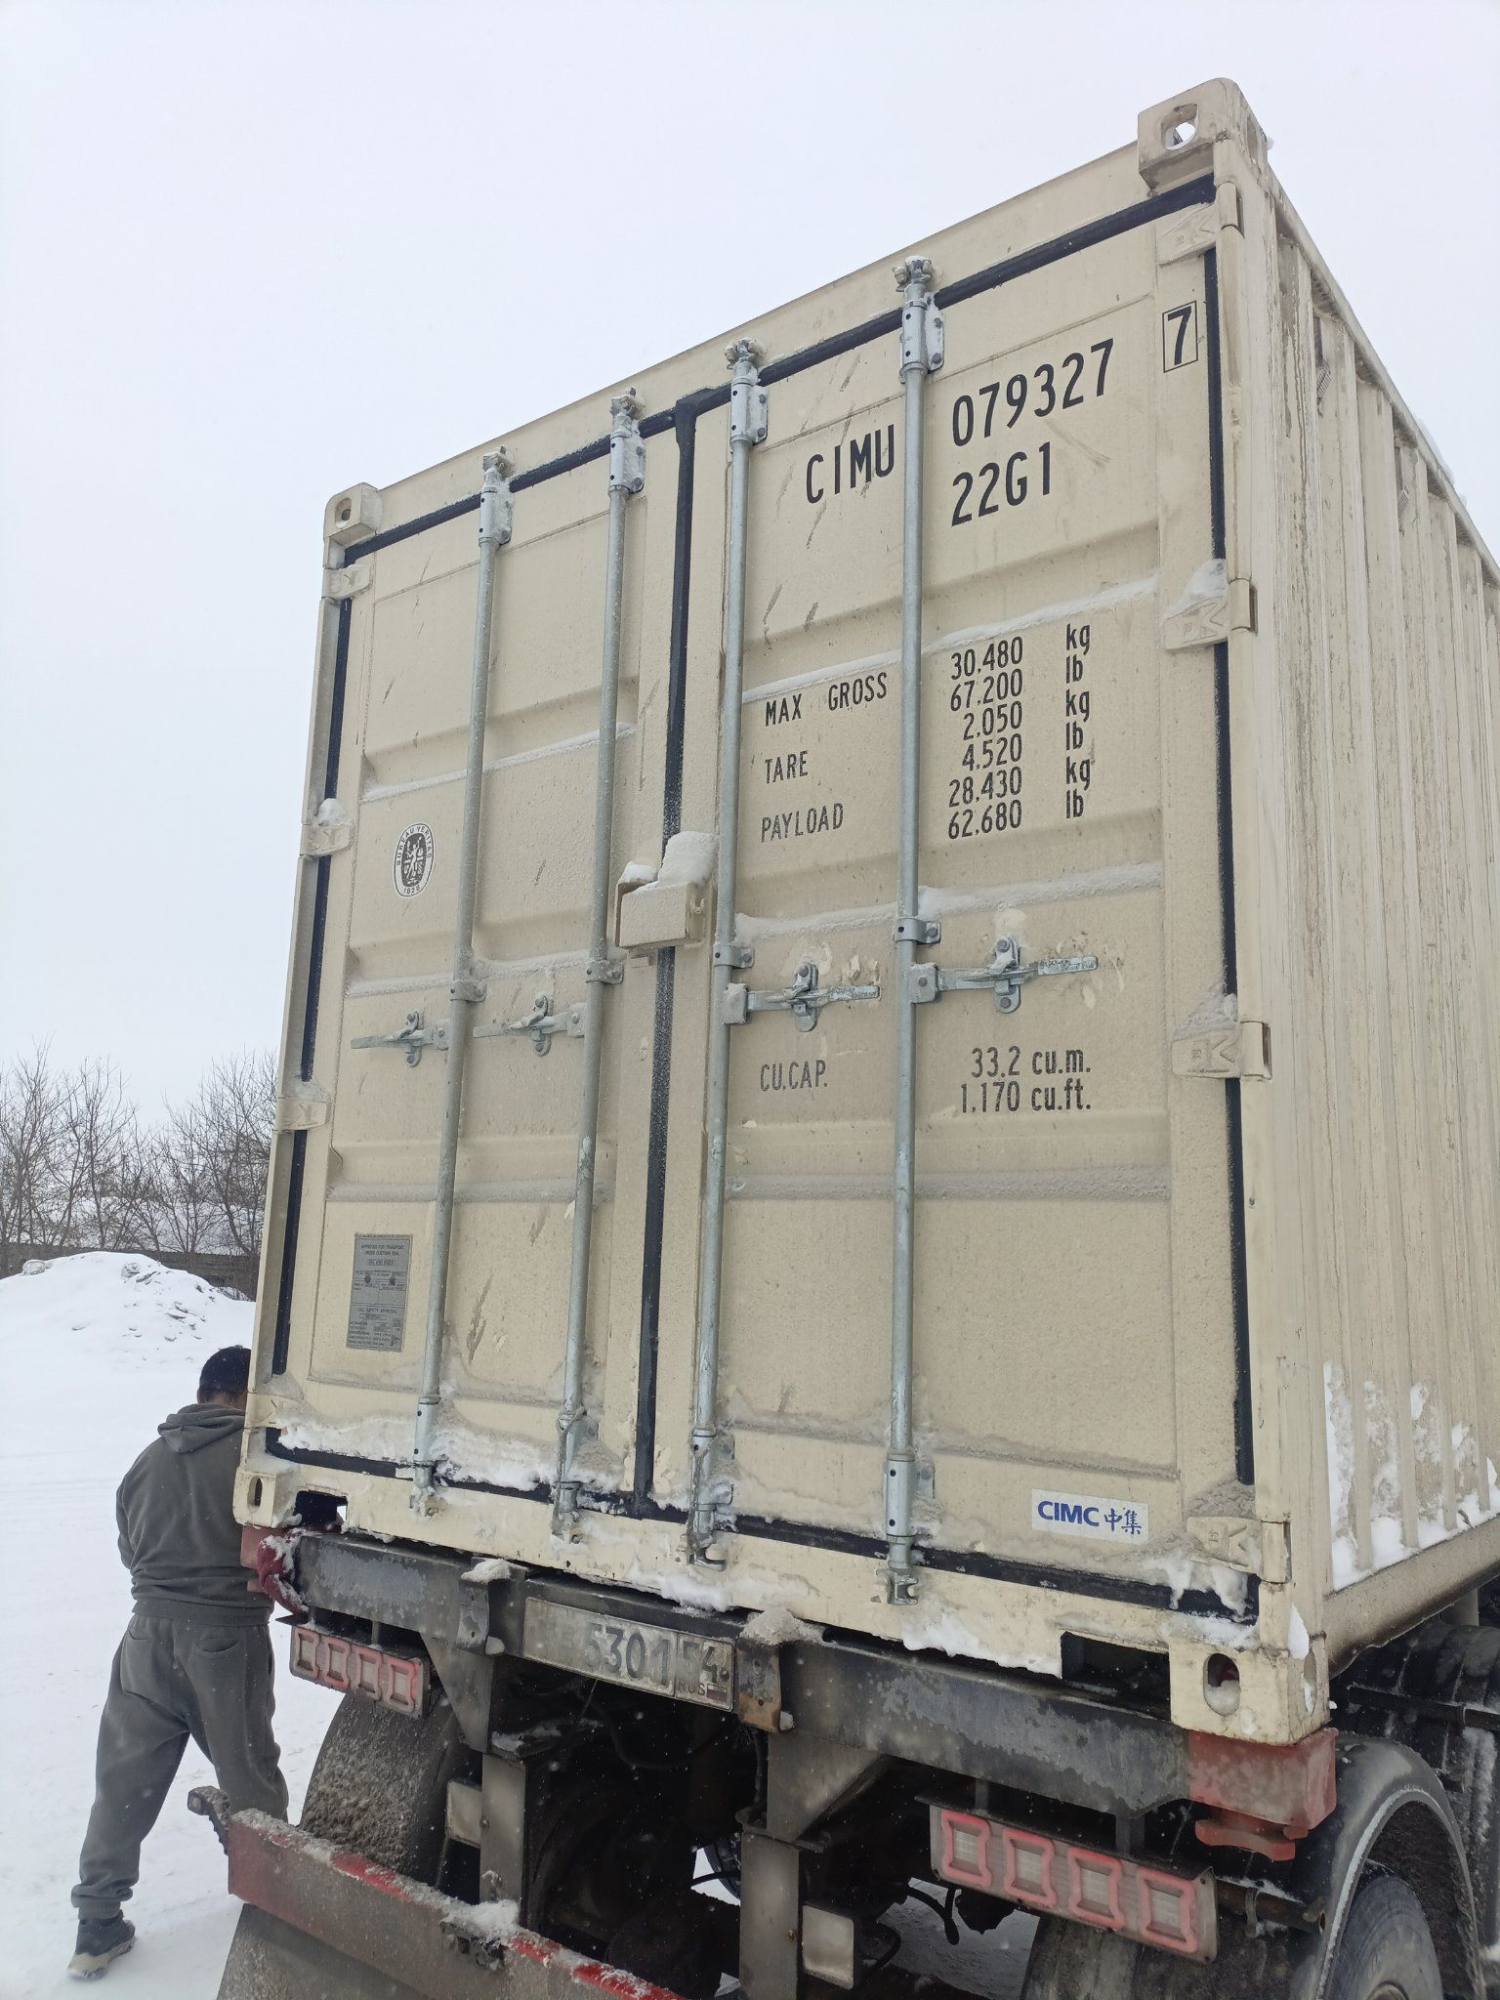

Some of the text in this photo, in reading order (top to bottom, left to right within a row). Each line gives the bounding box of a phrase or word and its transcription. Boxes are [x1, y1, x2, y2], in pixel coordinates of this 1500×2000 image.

[806, 305, 1192, 504] CIMU 079327 7
[951, 441, 1051, 527] 22G1
[765, 624, 1091, 726] MAX GROSS 30.480 kg
[950, 655, 1084, 712] 67.200 lb
[765, 689, 1090, 784] TARE 2.050 kg
[961, 722, 1084, 771] 4.520 lb
[761, 757, 1091, 843] PAYLOAD 28.430 kg
[948, 791, 1084, 840] 62.680 lb
[971, 1046, 1021, 1078] 33.2
[1031, 1049, 1091, 1075] cu.m.
[960, 1078, 1091, 1113] 1.170 cu.ft.
[1037, 1500, 1142, 1535] CIMC 中集
